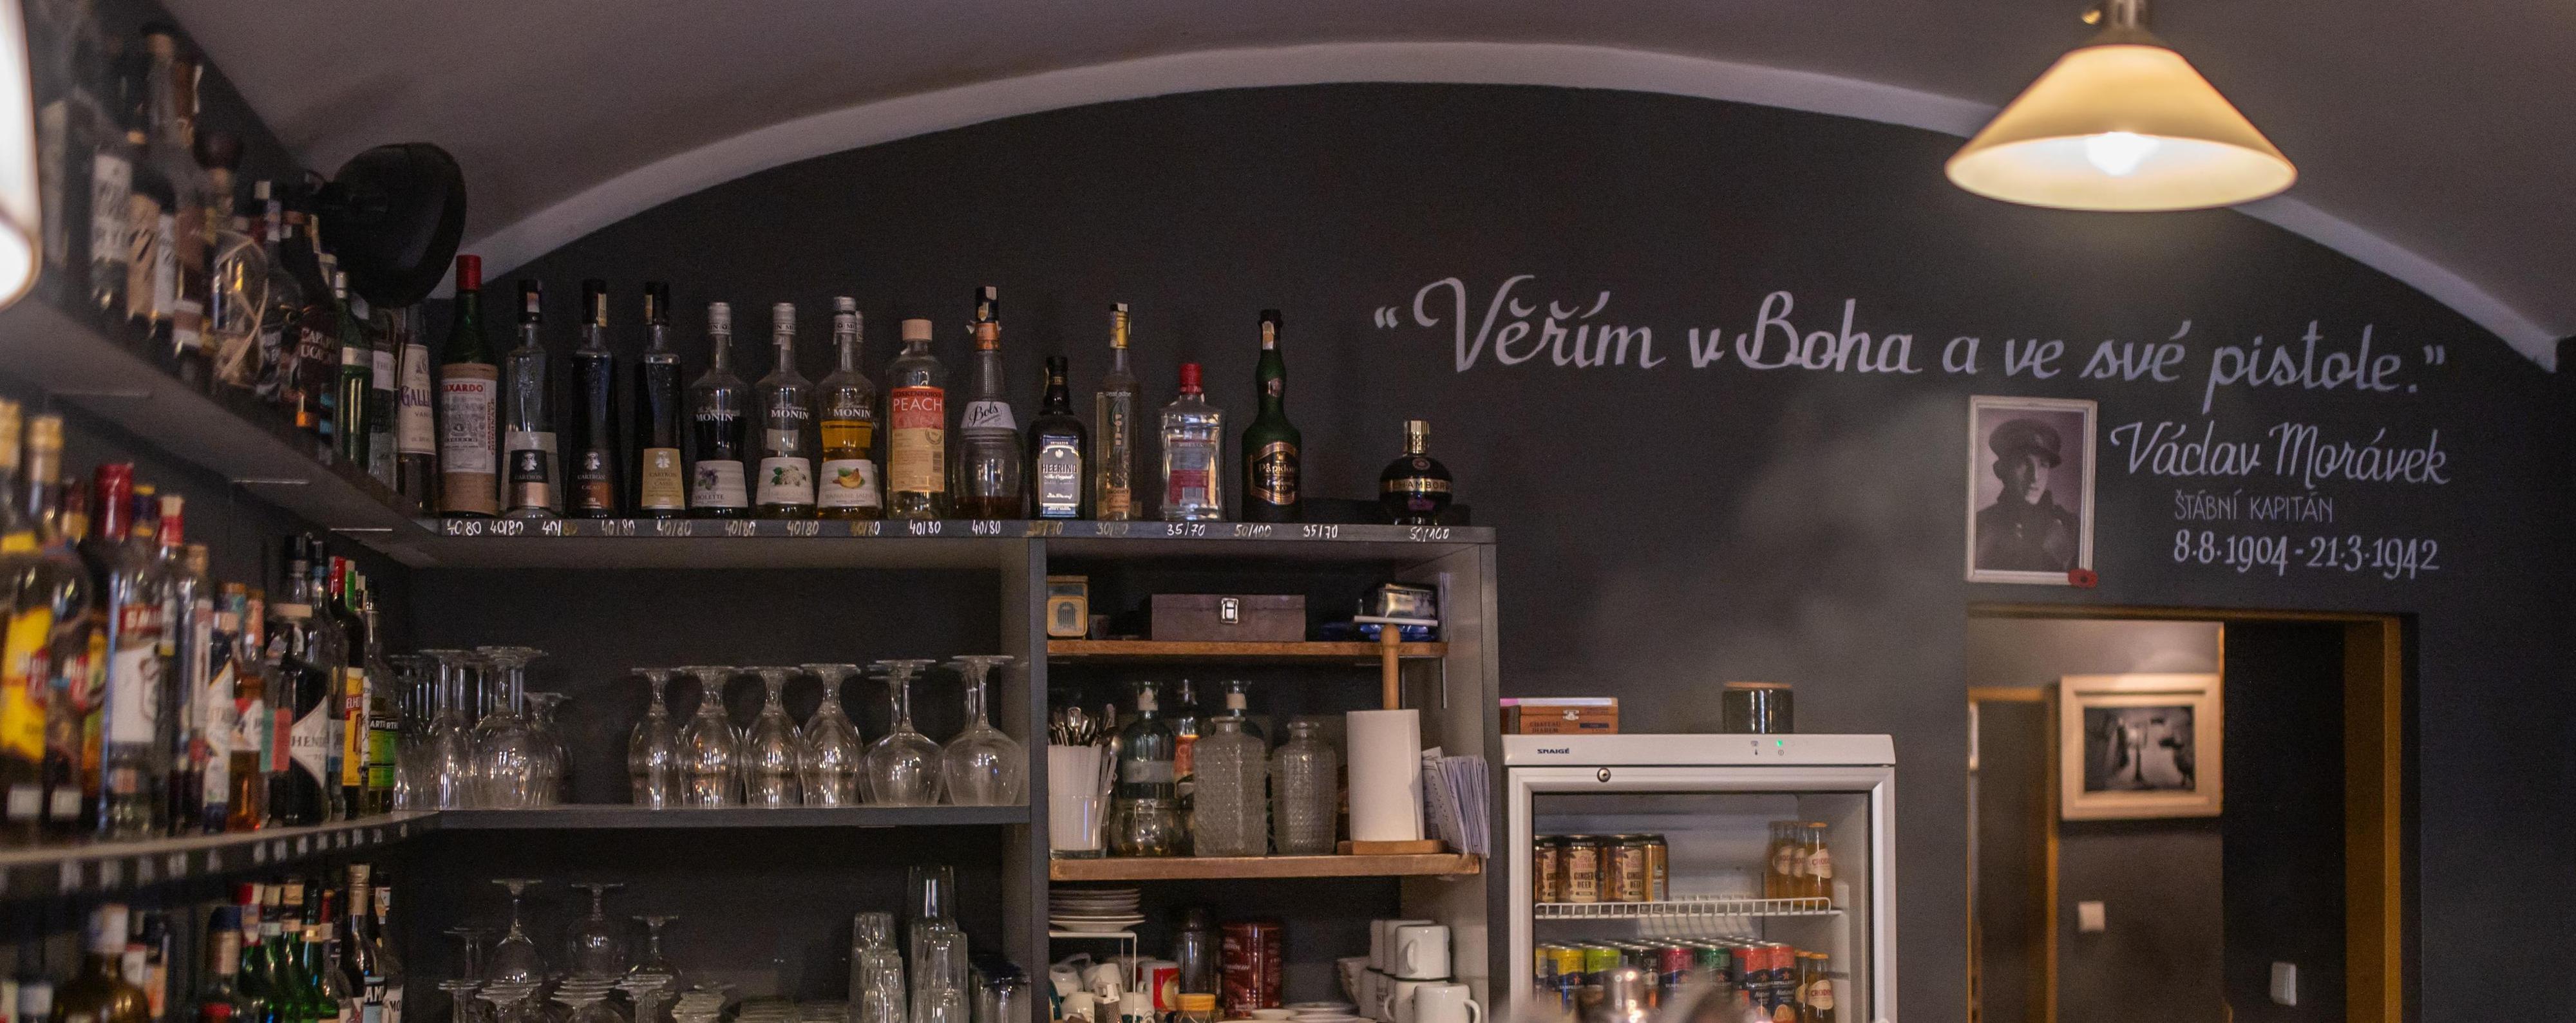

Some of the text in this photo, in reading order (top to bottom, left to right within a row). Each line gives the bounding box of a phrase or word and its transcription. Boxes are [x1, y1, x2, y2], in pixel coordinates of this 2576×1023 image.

[1688, 328, 1725, 369] v
[1735, 290, 1922, 373] Boha
[1942, 337, 1980, 375] a
[2005, 339, 2065, 379] ve
[2080, 320, 2192, 382] své
[893, 397, 943, 412] PEACH
[696, 413, 734, 422] MONIN
[771, 409, 809, 420] MONIN
[833, 408, 871, 418] MONIN
[969, 400, 999, 426] Bols
[2110, 420, 2450, 489] Václav Morávek
[2175, 489, 2333, 523] ŠTÁBNÍ KAPITÁN
[490, 520, 524, 535] 40/80
[601, 520, 635, 536] 40/80
[725, 520, 756, 537] 40/80
[786, 520, 819, 537] 40/80
[909, 520, 942, 536] 40/80
[972, 519, 1001, 535] 40/80
[1166, 522, 1206, 537] 35/70
[1233, 524, 1273, 538] 50/100
[1303, 524, 1338, 539] 35/70
[1409, 527, 1450, 542] 50/100
